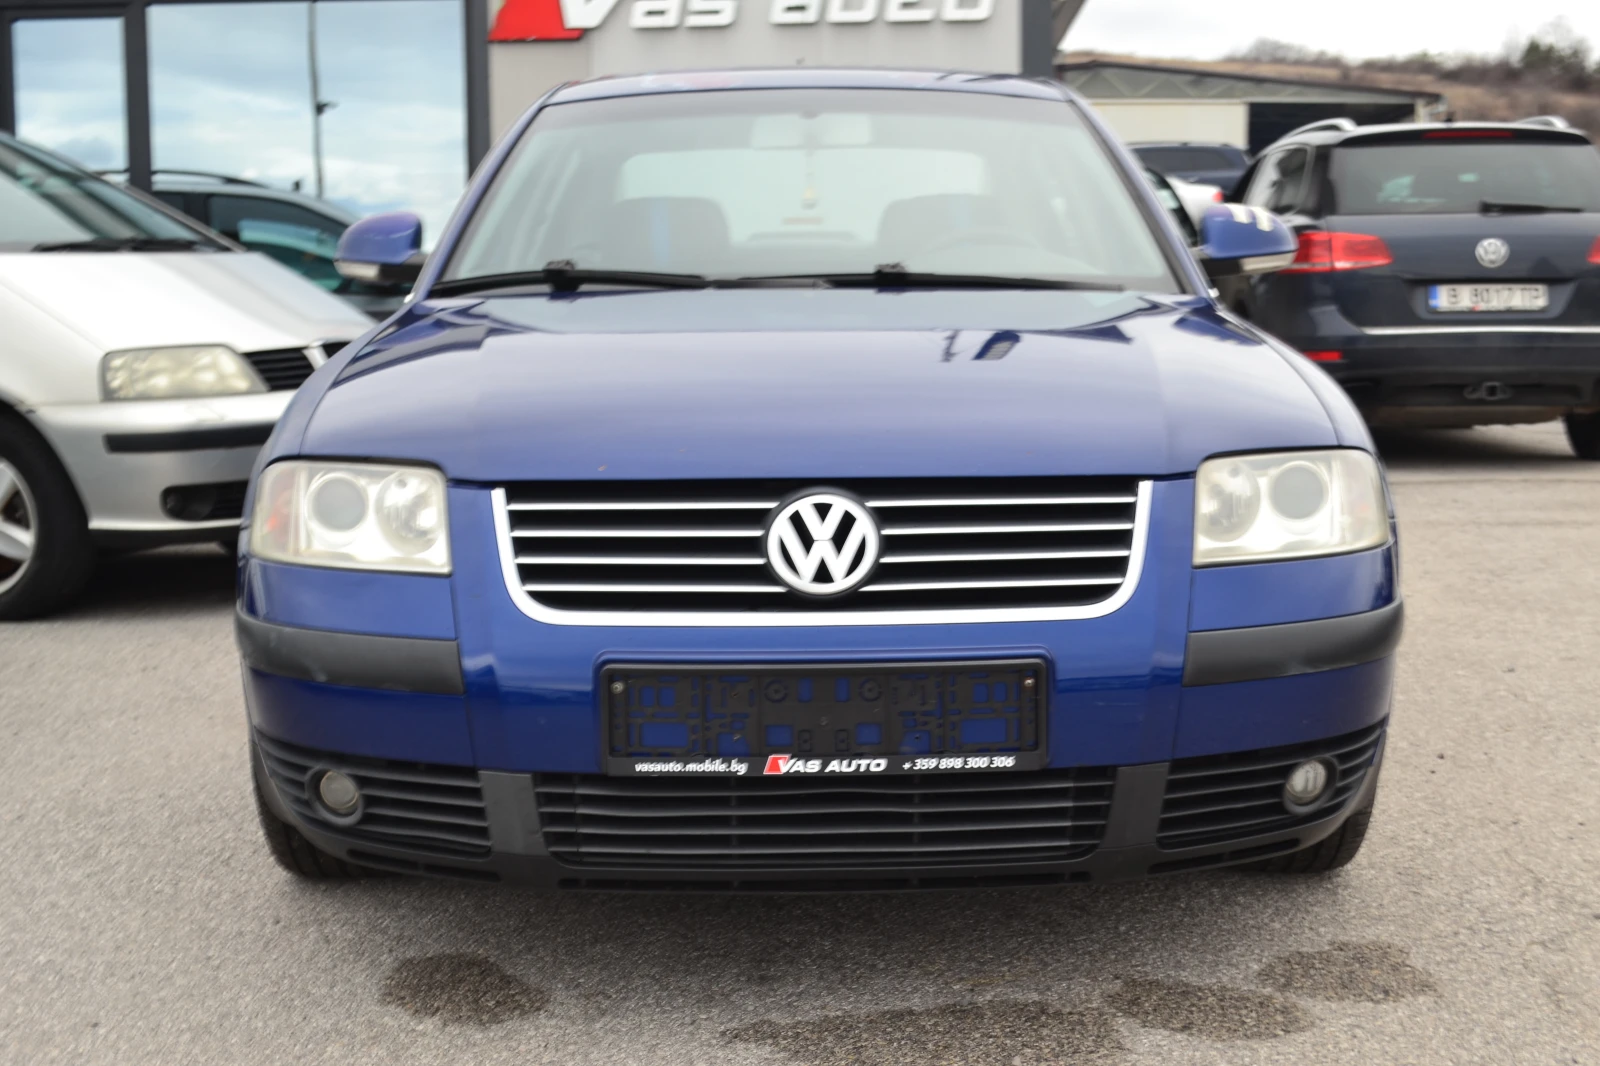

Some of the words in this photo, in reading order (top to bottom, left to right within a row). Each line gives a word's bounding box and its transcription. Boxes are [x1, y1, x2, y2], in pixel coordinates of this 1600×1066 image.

[634, 758, 749, 775] vasauto.mobile.bg
[778, 758, 823, 773] VAS
[824, 758, 888, 773] AUTO
[938, 757, 964, 769] 898
[964, 756, 990, 768] 300
[990, 755, 1016, 768] 306
